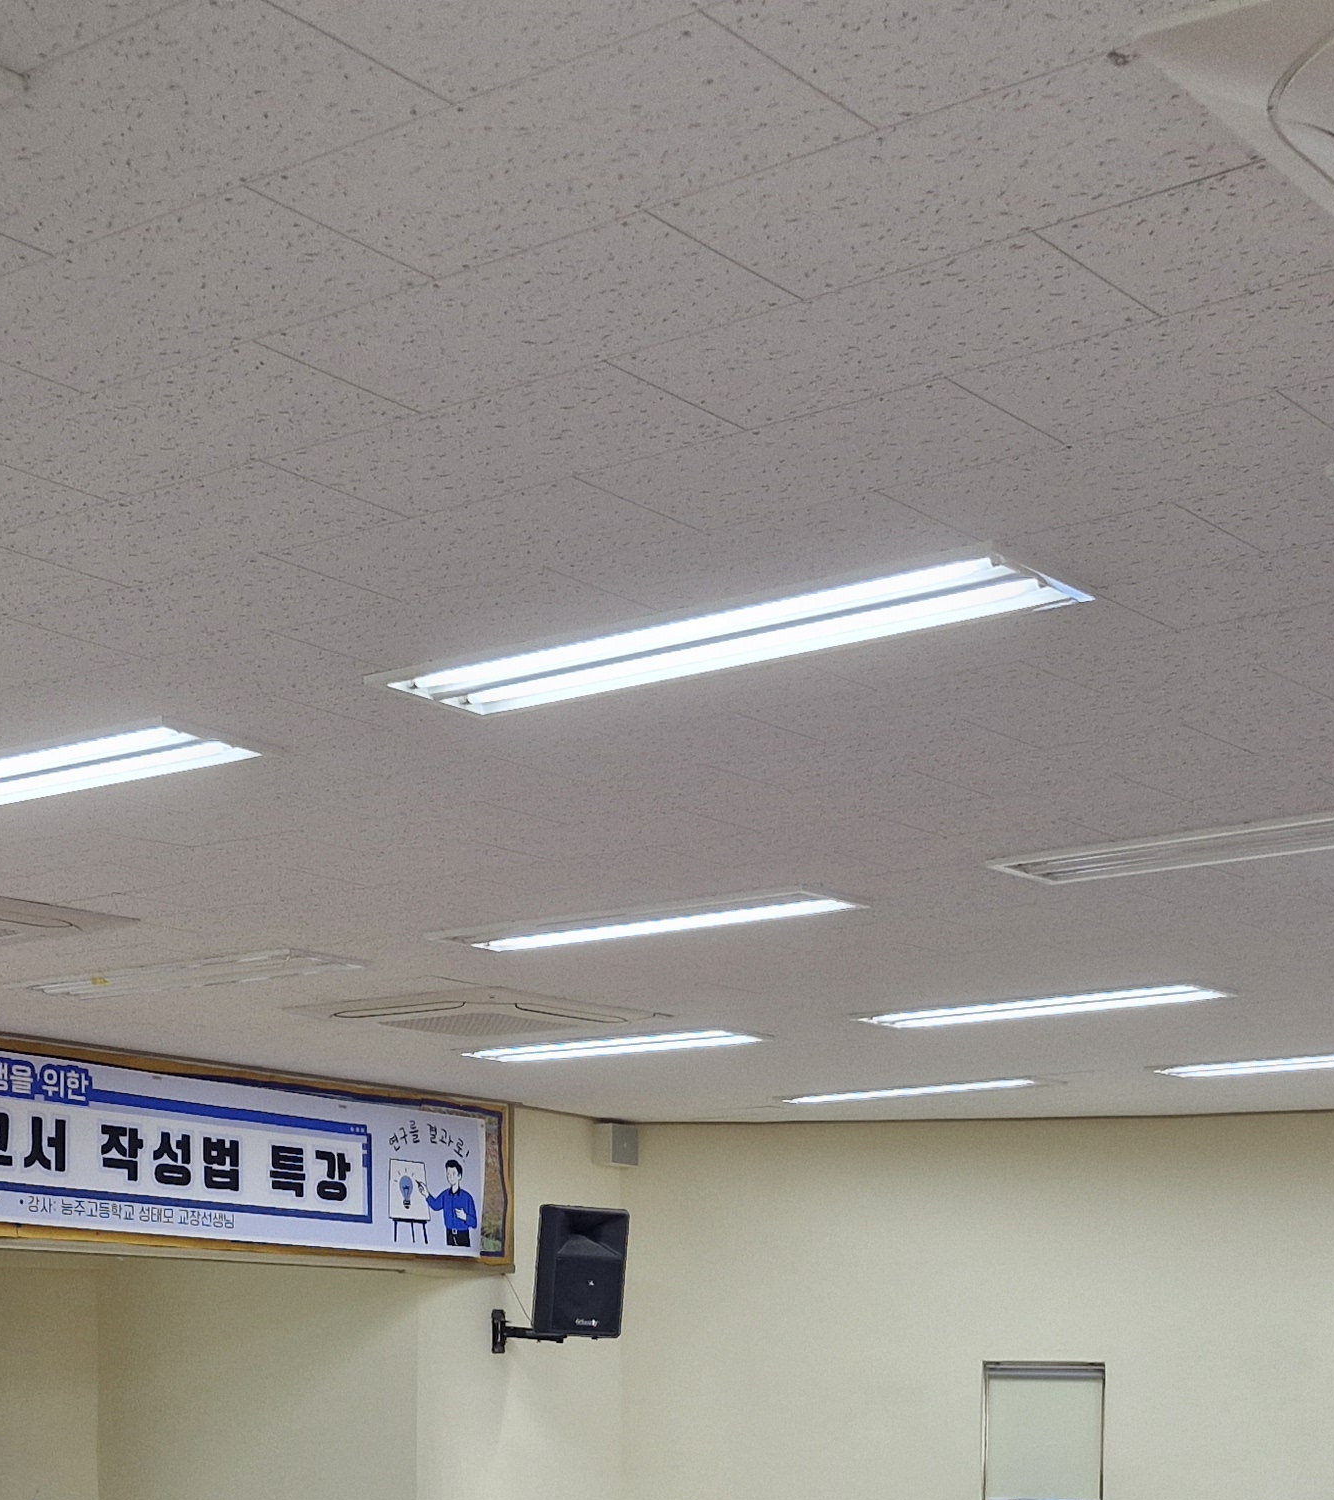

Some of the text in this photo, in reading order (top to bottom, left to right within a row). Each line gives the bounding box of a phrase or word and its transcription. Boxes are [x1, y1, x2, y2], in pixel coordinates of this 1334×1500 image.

[41, 1066, 89, 1101] 위한
[389, 1120, 420, 1151] 연구를
[100, 1124, 240, 1192] 작성법
[269, 1144, 351, 1201] 특강
[28, 1196, 57, 1214] 강사:
[61, 1200, 135, 1221] 능주고등학교
[178, 1209, 235, 1229] 교장선생님
